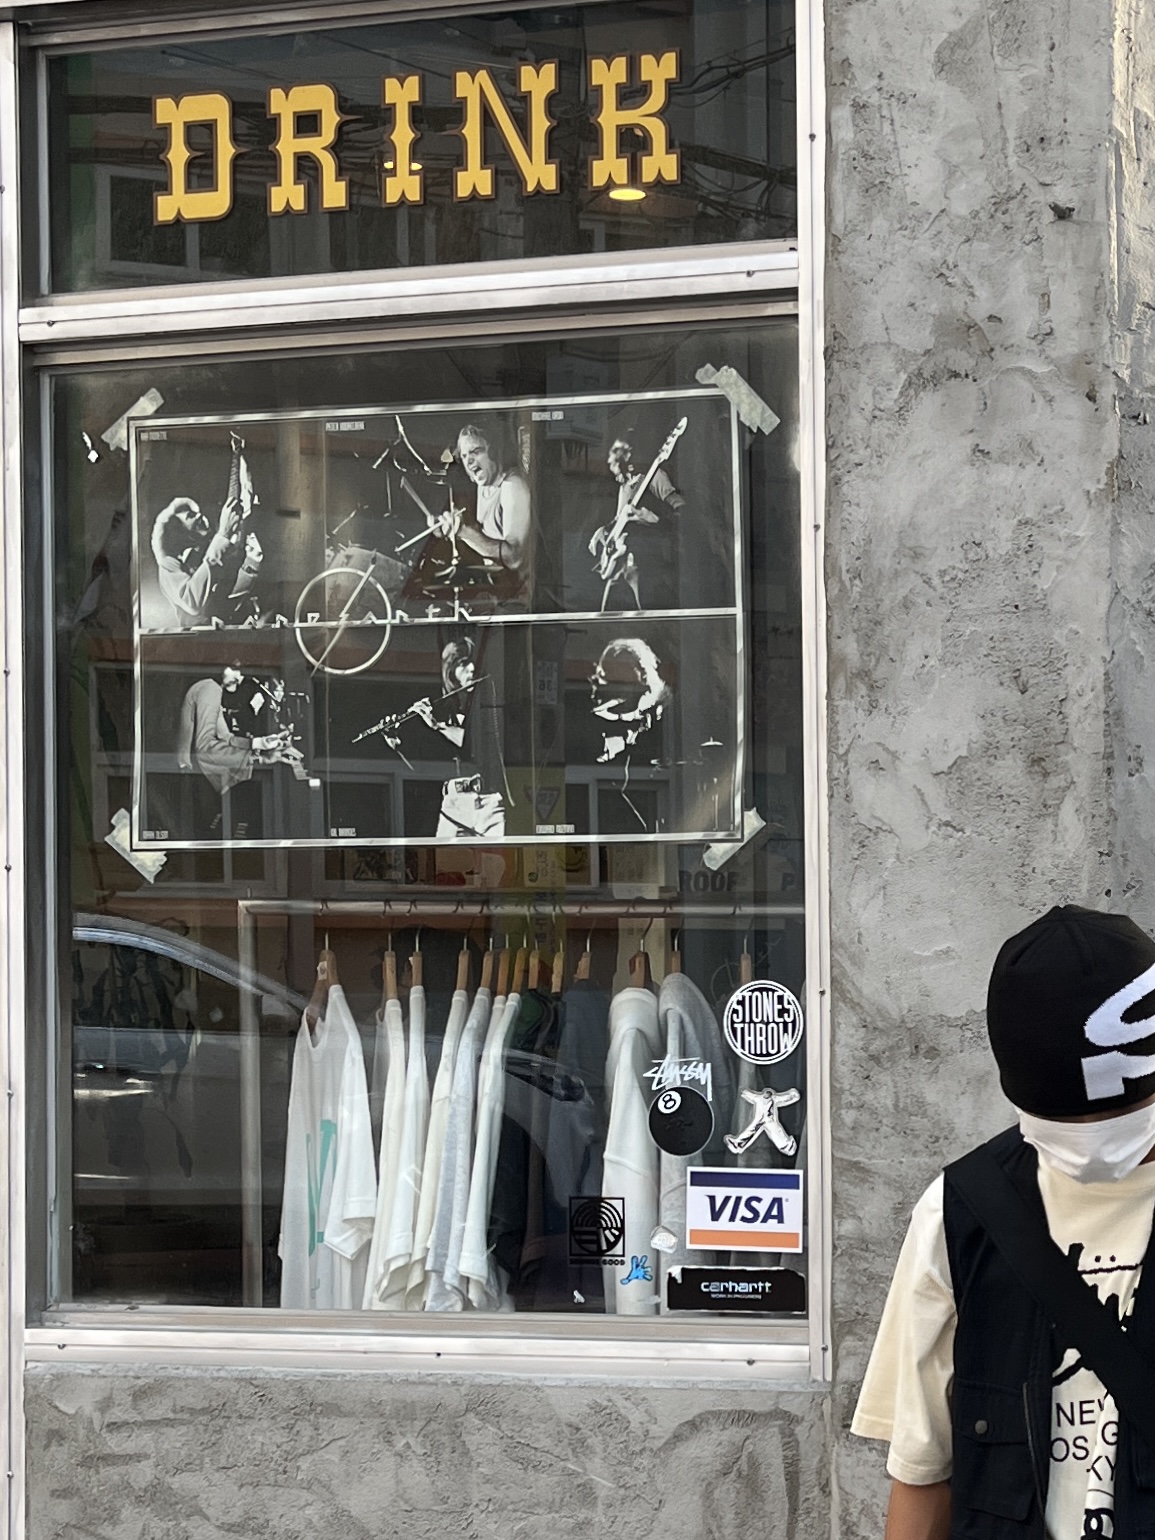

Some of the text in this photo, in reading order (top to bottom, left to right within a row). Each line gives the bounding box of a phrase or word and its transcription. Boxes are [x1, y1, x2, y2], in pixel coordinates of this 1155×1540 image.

[153, 47, 682, 226] DRINK
[732, 991, 794, 1022] STONES
[733, 1023, 793, 1054] THROW
[662, 1094, 677, 1110] 8
[705, 1195, 785, 1224] VISA
[700, 1281, 772, 1293] carhartt
